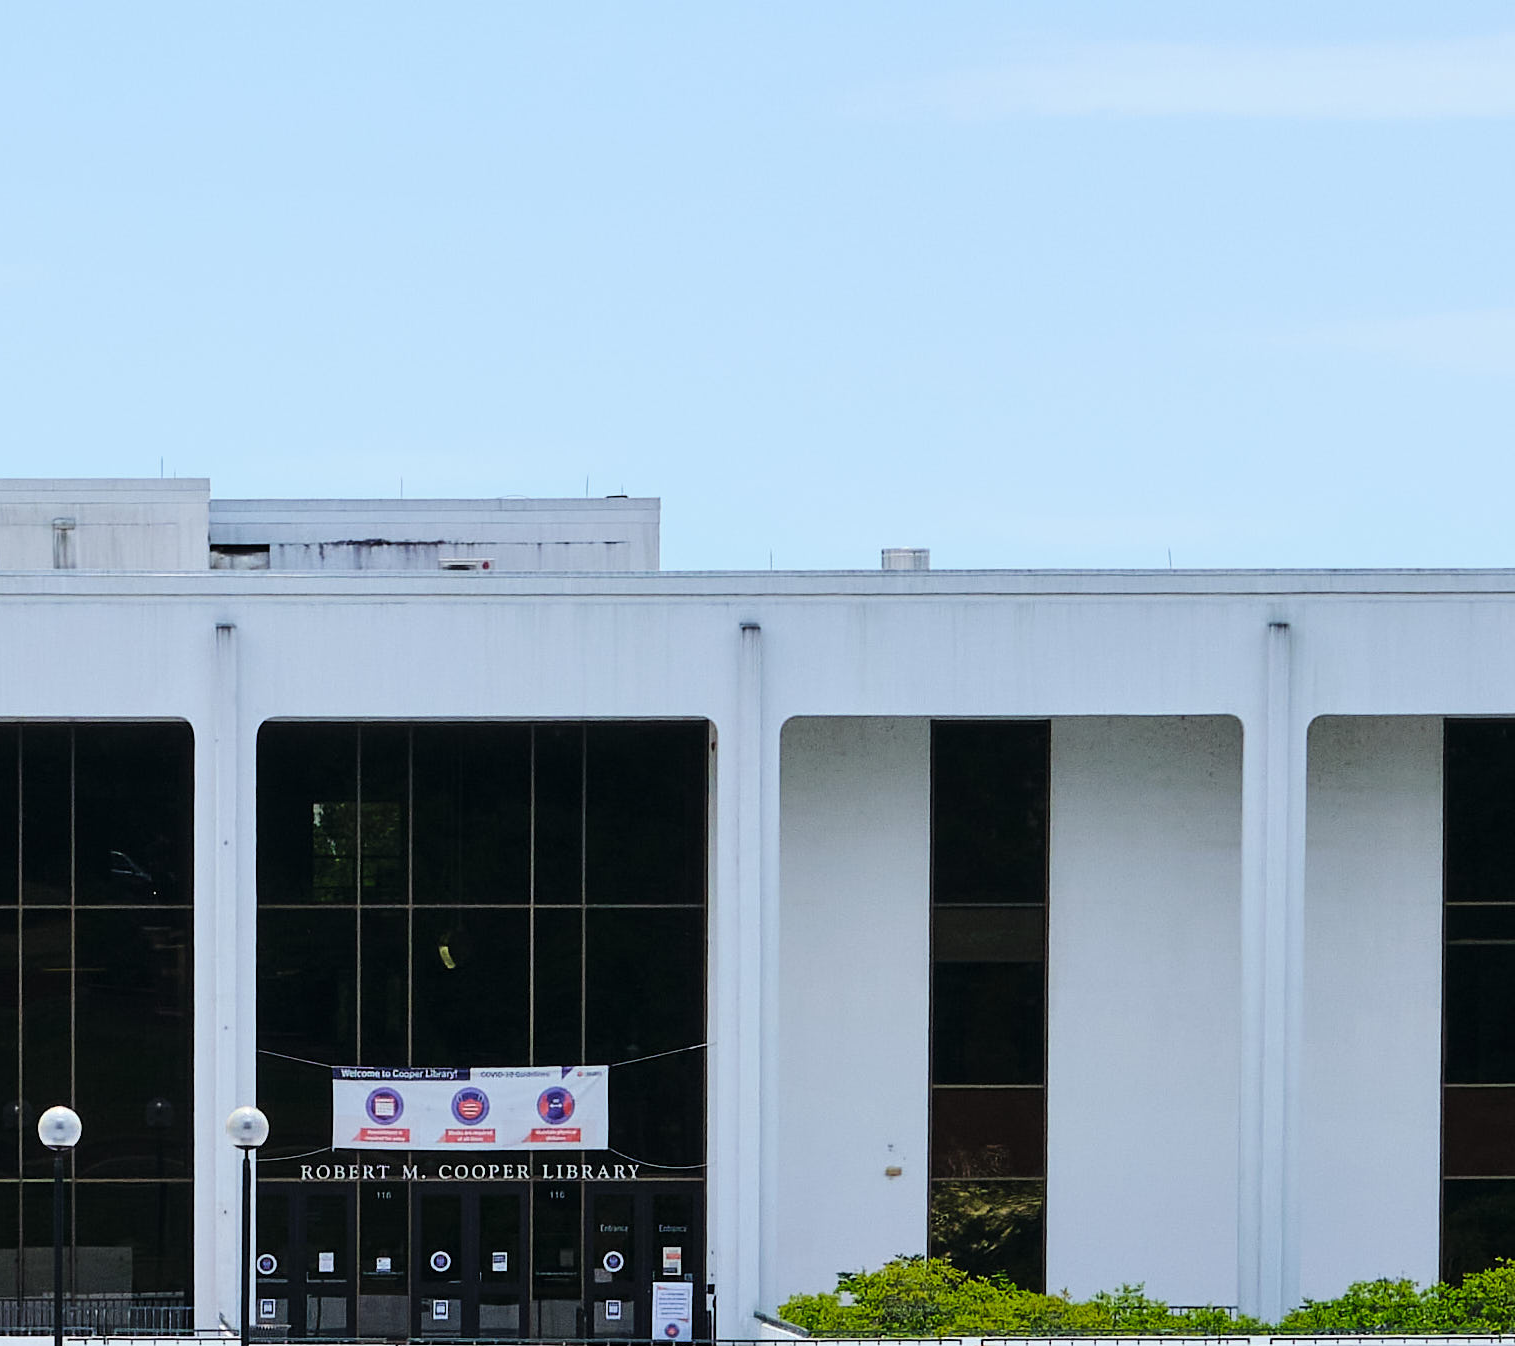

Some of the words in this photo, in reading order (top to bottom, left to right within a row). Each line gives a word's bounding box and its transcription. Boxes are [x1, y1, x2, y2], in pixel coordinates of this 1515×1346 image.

[340, 1068, 380, 1078] Welcome
[382, 1068, 391, 1078] to
[392, 1069, 424, 1080] Cooper
[300, 1163, 390, 1180] ROBERT
[402, 1163, 427, 1180] M.
[438, 1163, 531, 1180] COOPER
[542, 1163, 641, 1180] LIBRARY
